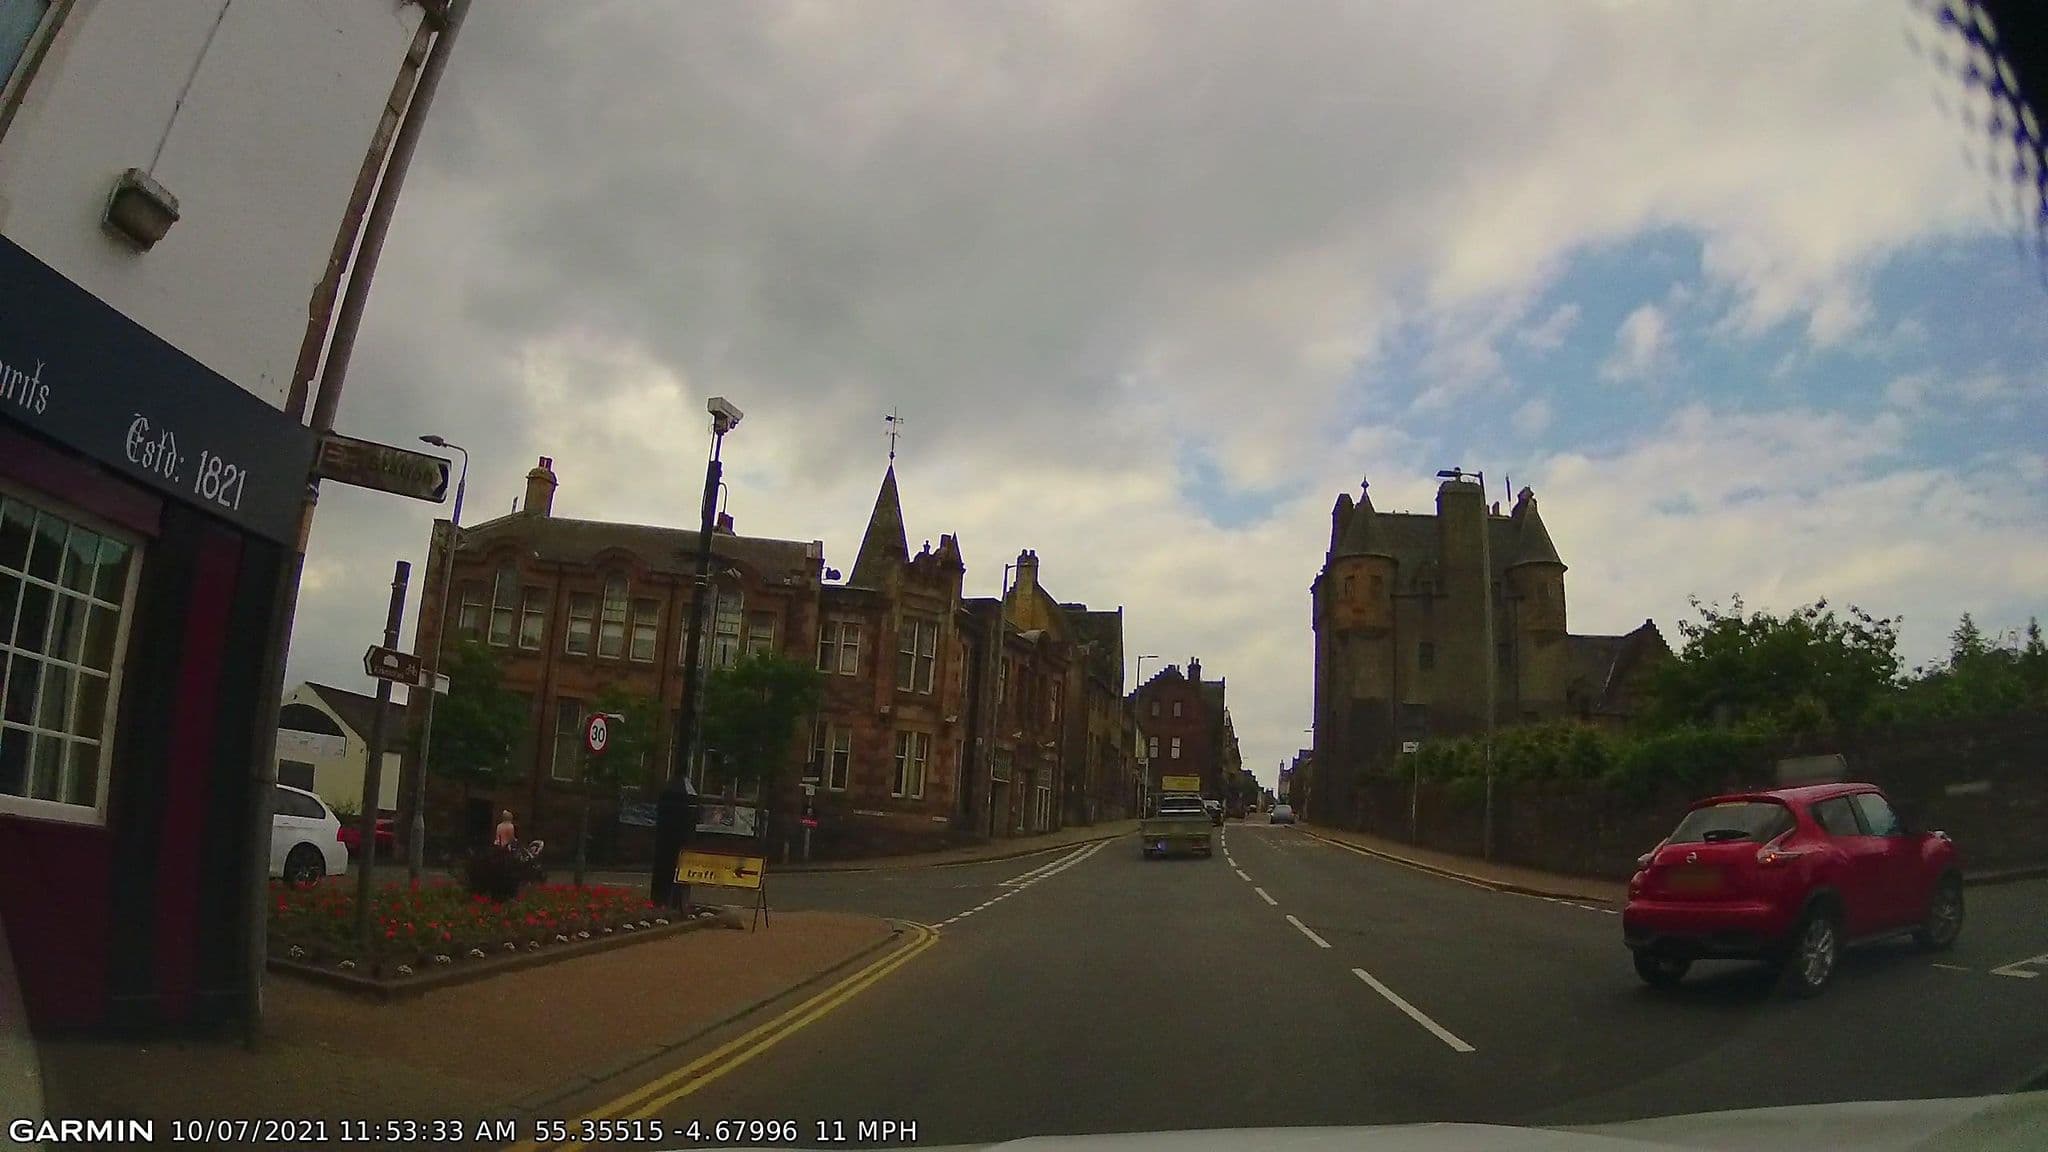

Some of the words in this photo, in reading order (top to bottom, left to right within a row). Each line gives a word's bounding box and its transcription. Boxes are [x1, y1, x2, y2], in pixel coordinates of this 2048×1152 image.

[0, 358, 50, 415] irits
[194, 449, 247, 511] 1821
[591, 724, 605, 743] 30
